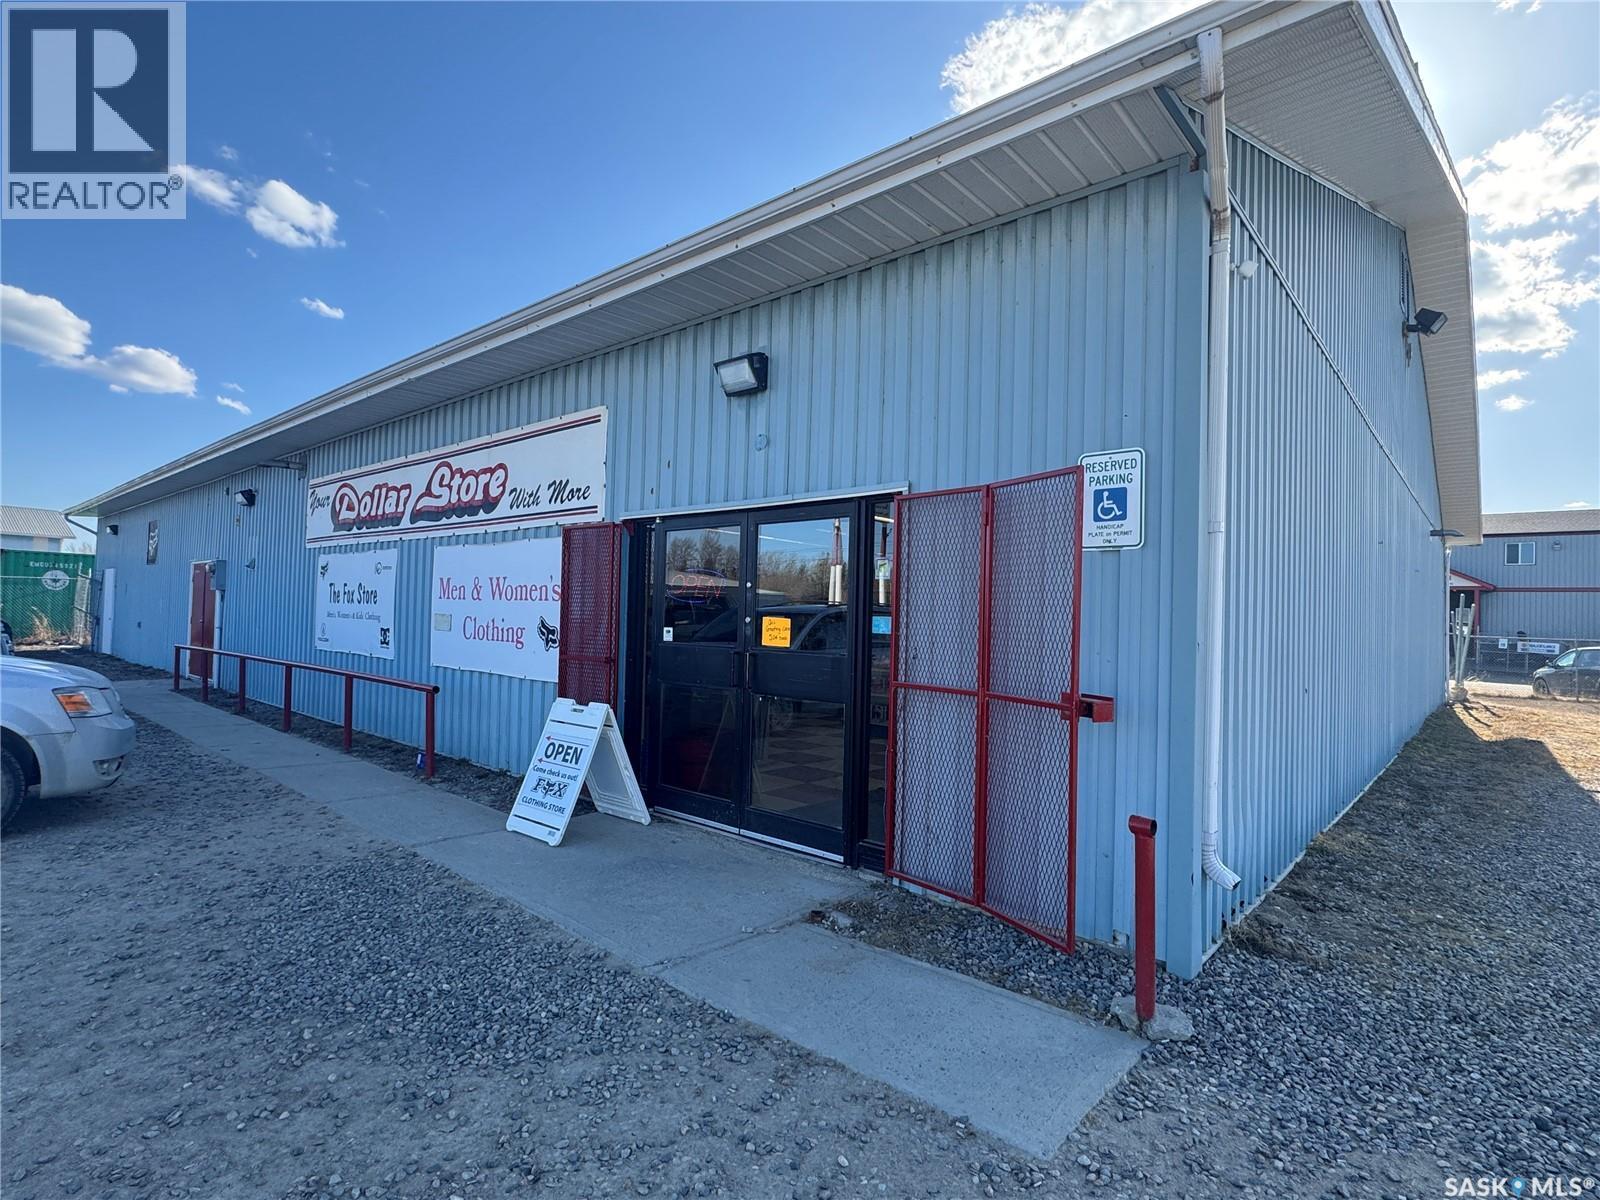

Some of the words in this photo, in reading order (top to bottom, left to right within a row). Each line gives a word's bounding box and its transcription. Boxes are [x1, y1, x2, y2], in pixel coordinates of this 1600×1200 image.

[1085, 458, 1137, 473] RESERVED
[1088, 473, 1133, 487] PARKING
[309, 487, 331, 516] Your
[331, 482, 412, 532] Dollar
[410, 460, 509, 525] Store
[508, 484, 542, 510] With
[547, 478, 592, 505] More
[329, 582, 341, 604] The
[342, 582, 356, 605] Fox
[357, 582, 378, 605] Store
[438, 577, 467, 600] Men
[471, 578, 483, 600] &
[489, 575, 561, 602] Women's
[462, 616, 526, 650] Clothing
[544, 742, 583, 765] OPEN
[533, 764, 546, 773] Come
[546, 768, 561, 778] check
[568, 774, 579, 782] out!
[521, 795, 549, 810] CLOTHING
[548, 803, 566, 815] STORE
